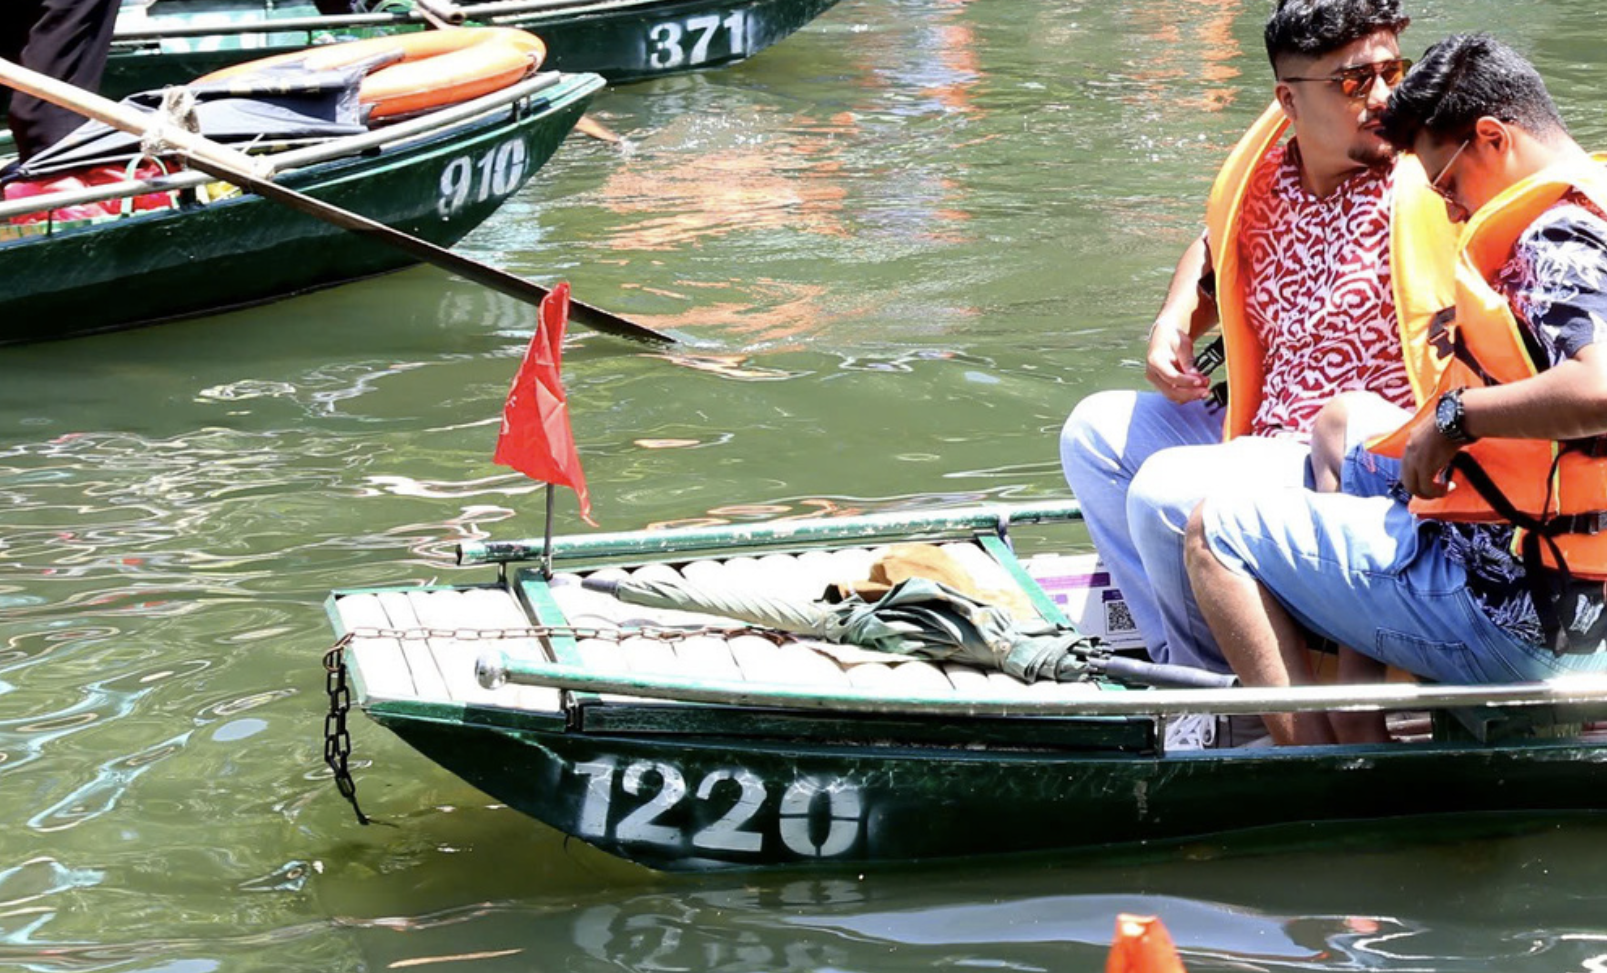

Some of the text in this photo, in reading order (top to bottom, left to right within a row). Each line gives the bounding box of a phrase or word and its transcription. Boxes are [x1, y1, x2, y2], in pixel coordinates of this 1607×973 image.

[650, 9, 744, 68] 371
[439, 138, 525, 215] 910
[574, 761, 861, 857] 1220
